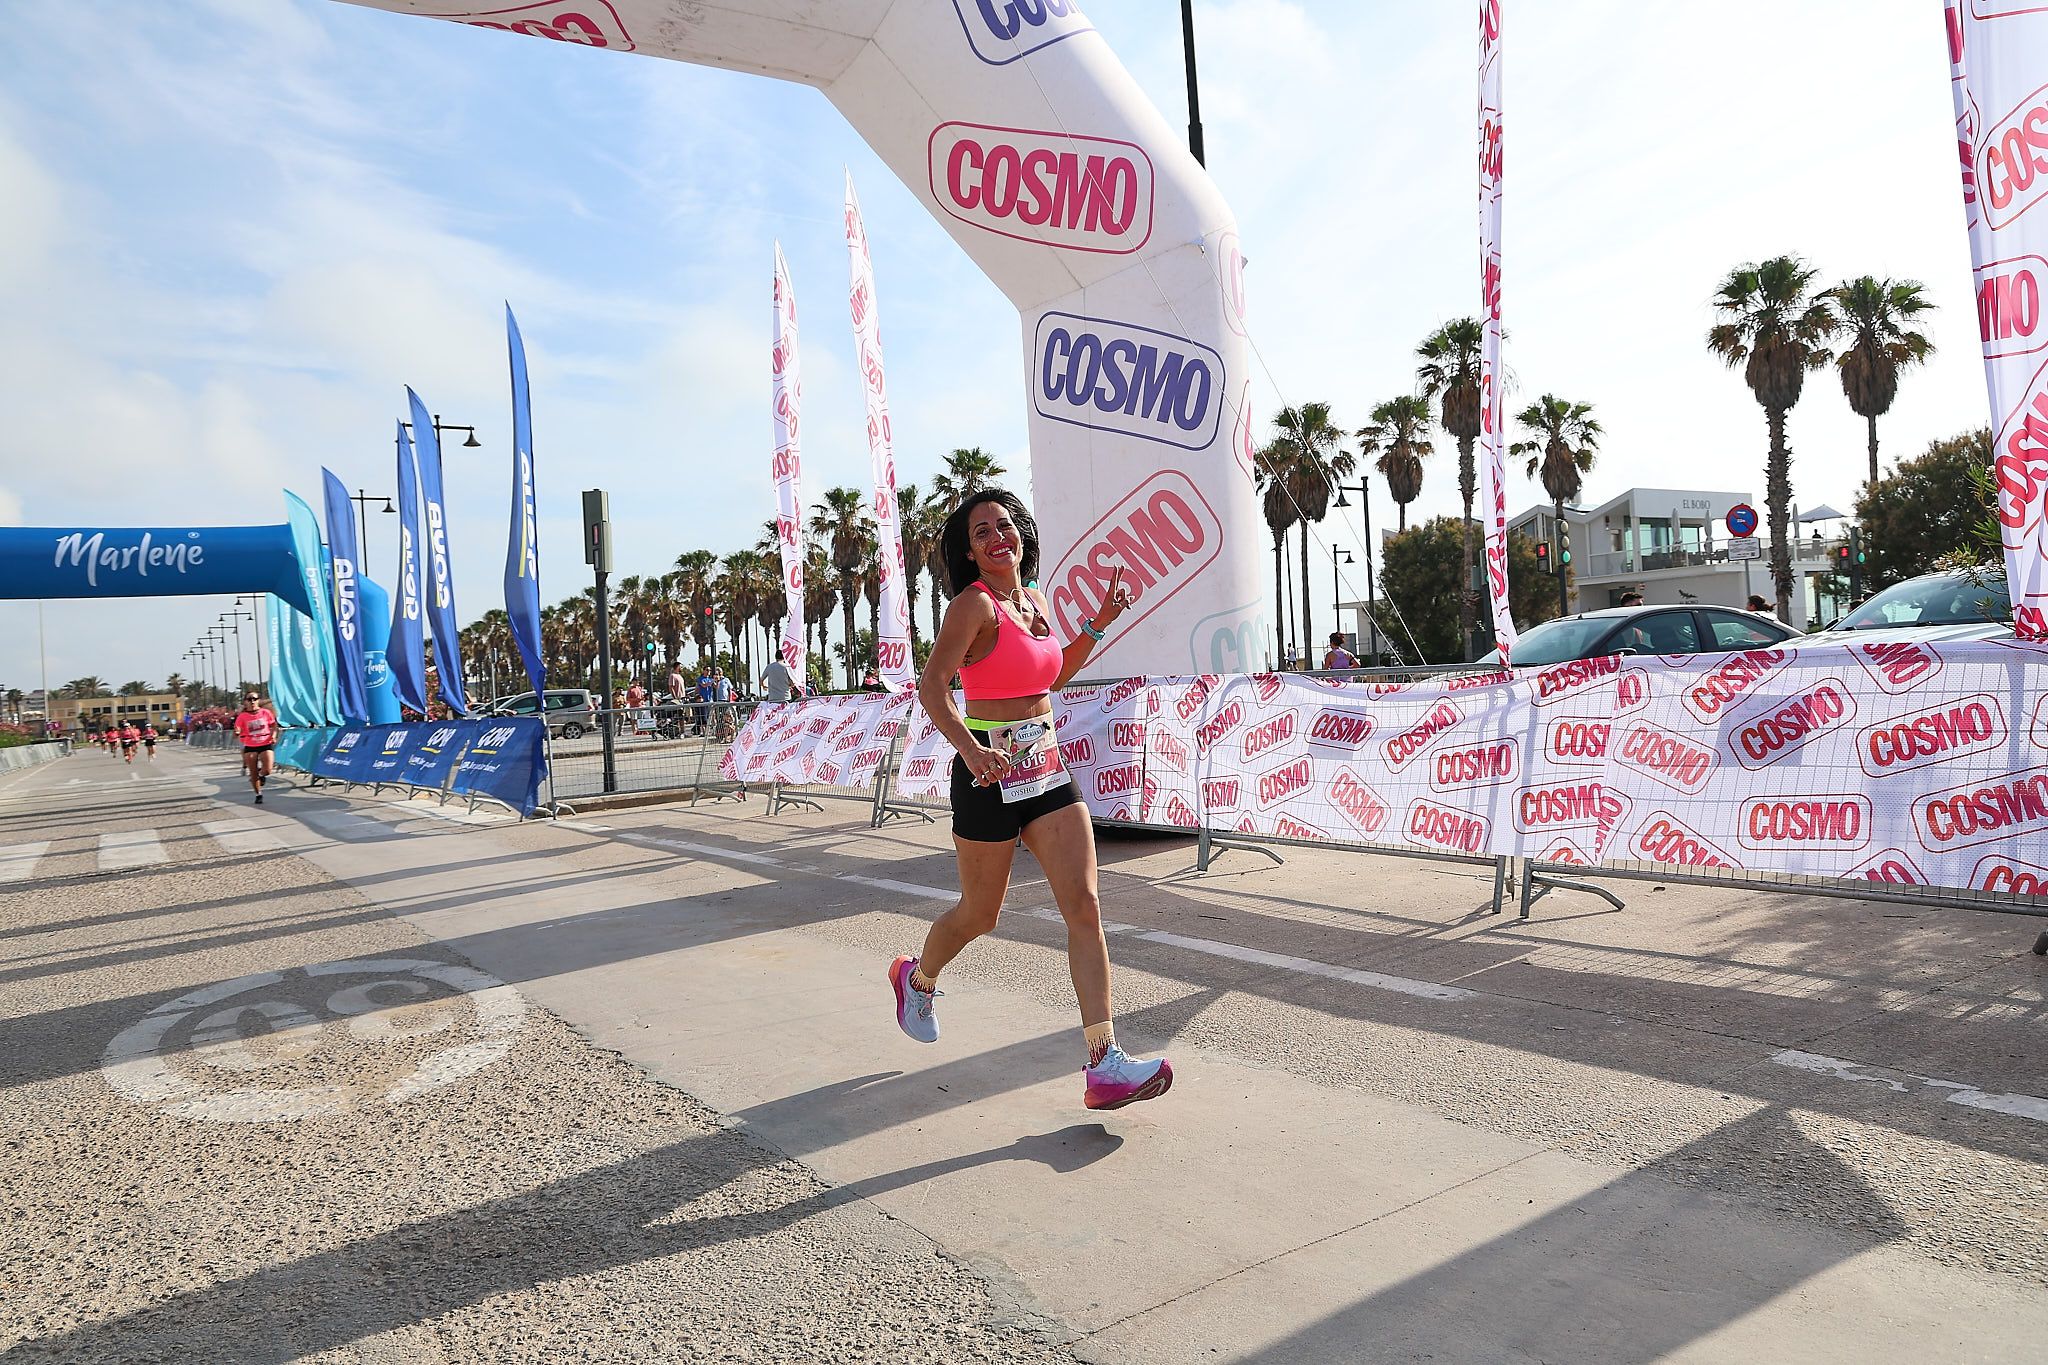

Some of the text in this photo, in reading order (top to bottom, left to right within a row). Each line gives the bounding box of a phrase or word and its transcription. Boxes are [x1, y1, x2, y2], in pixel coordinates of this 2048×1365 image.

[947, 138, 1138, 237] COSMO
[1978, 269, 2040, 342] MO
[1041, 326, 1212, 433] COSMO
[54, 532, 204, 587] Marlene
[1053, 489, 1205, 643] COSMO
[1210, 612, 1265, 674] CO
[1539, 654, 1621, 698] COSMO
[827, 711, 857, 743] COSMO
[1195, 701, 1241, 753] COSMO
[1245, 713, 1293, 757] COSMO
[1312, 713, 1372, 745] COSMO
[1387, 703, 1458, 765] COSMO
[1741, 686, 1845, 761] COSMO
[1869, 702, 1993, 767] COSMO
[852, 749, 883, 770] COSMO
[905, 759, 936, 778] COSMO
[1059, 737, 1091, 765] SMO
[1437, 743, 1512, 785] COSMO
[1622, 726, 1711, 786] COSMO
[1011, 786, 1035, 797] OYSHO
[1097, 764, 1141, 795] COSMO
[1202, 780, 1239, 809] COSMO
[1259, 759, 1310, 804] COSMO
[1330, 772, 1386, 832] COSMO
[1521, 783, 1602, 826] COSMO
[1750, 801, 1861, 841] COSMO
[1926, 774, 2048, 842] COSMO
[1410, 805, 1483, 853] COSMO
